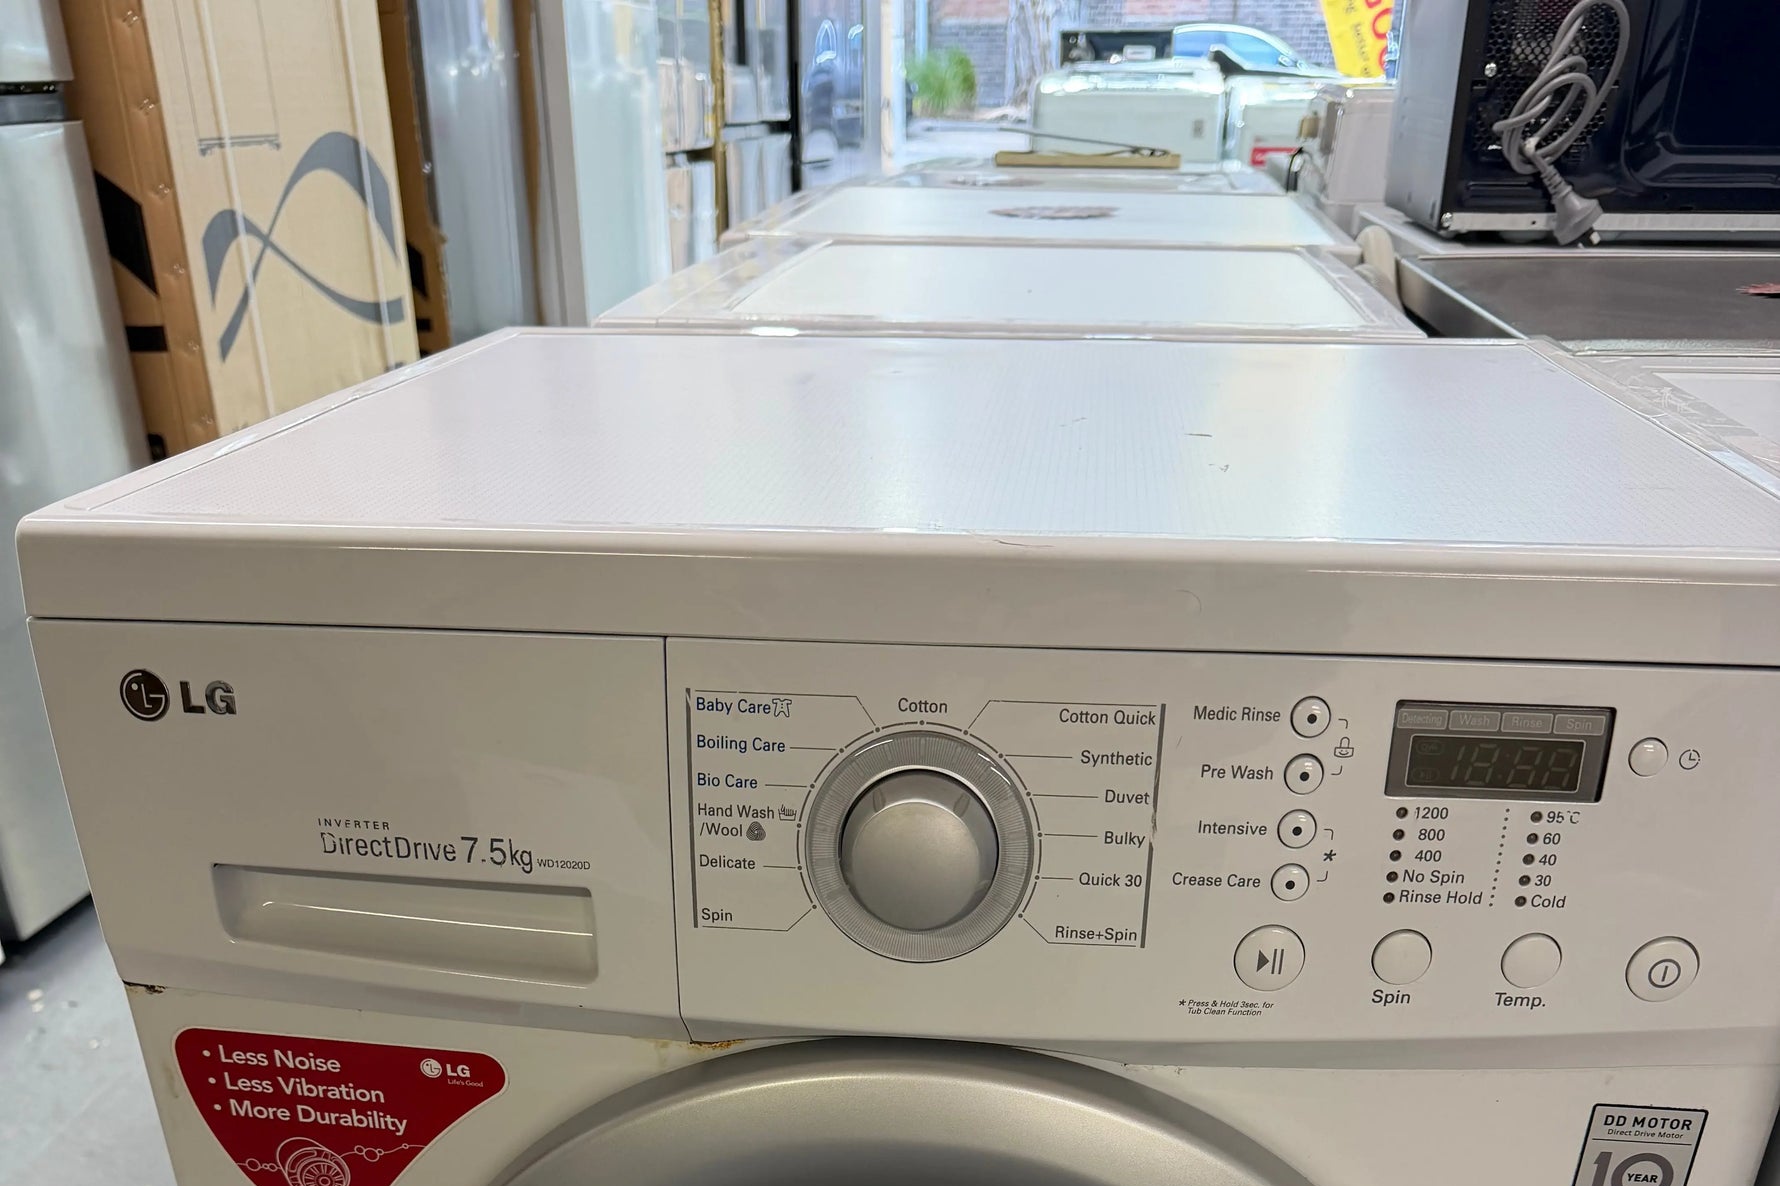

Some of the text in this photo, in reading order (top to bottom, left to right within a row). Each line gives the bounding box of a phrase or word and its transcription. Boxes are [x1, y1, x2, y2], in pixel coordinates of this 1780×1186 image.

[180, 680, 237, 715] LG
[898, 697, 948, 713] Cotton
[696, 697, 771, 715] Baby Care
[1059, 708, 1156, 726] Cotton Quick
[1193, 706, 1281, 722] Medic Rinse
[1402, 712, 1443, 727] Detecting
[1459, 714, 1490, 726] Wash
[1512, 717, 1543, 728] Rinse
[1566, 719, 1593, 731] Spin
[697, 734, 786, 754] Boiling Care
[1080, 750, 1153, 769] Synthetic
[1200, 764, 1274, 781] Pre Wash
[697, 774, 758, 789] Bio Care
[1104, 789, 1149, 805] Duvet
[697, 803, 775, 820] Hand Wash
[1414, 807, 1449, 819] 1200
[318, 818, 390, 830] INVERTER
[700, 821, 743, 837] /Wool
[1198, 821, 1267, 836] Intensive
[1104, 831, 1145, 849] Bulky
[1418, 828, 1446, 841] 800
[1542, 833, 1561, 845] 60
[461, 836, 533, 874] 7.5kg
[537, 858, 591, 870] WD12020D
[699, 855, 756, 870] Delicate
[1414, 850, 1442, 862] 400
[1538, 854, 1557, 866] 40
[1078, 872, 1142, 888] Quick 30
[1172, 872, 1261, 888] Crease Care
[1403, 869, 1465, 886] No Spin
[1534, 875, 1552, 887] 30
[1399, 890, 1483, 905] Rinse Hold
[1531, 894, 1566, 908] Cold
[701, 908, 733, 923] Spin
[1054, 925, 1137, 943] Rinse+Spin
[1187, 999, 1209, 1007] Press
[1220, 1000, 1238, 1008] Hold
[1262, 1001, 1274, 1009] for
[1371, 989, 1411, 1007] Spin
[1495, 992, 1547, 1010] Temp.
[1187, 1007, 1262, 1016] Tub Clean Function
[218, 1044, 341, 1073] Less Noise
[446, 1063, 471, 1078] LG
[224, 1072, 385, 1103] Less Vibration
[447, 1078, 465, 1086] Life's
[229, 1098, 407, 1136] More Durability
[1603, 1115, 1692, 1131] DD MOTOR
[1607, 1128, 1684, 1139] Direct Drive Motor
[1627, 1173, 1658, 1183] YEAR
